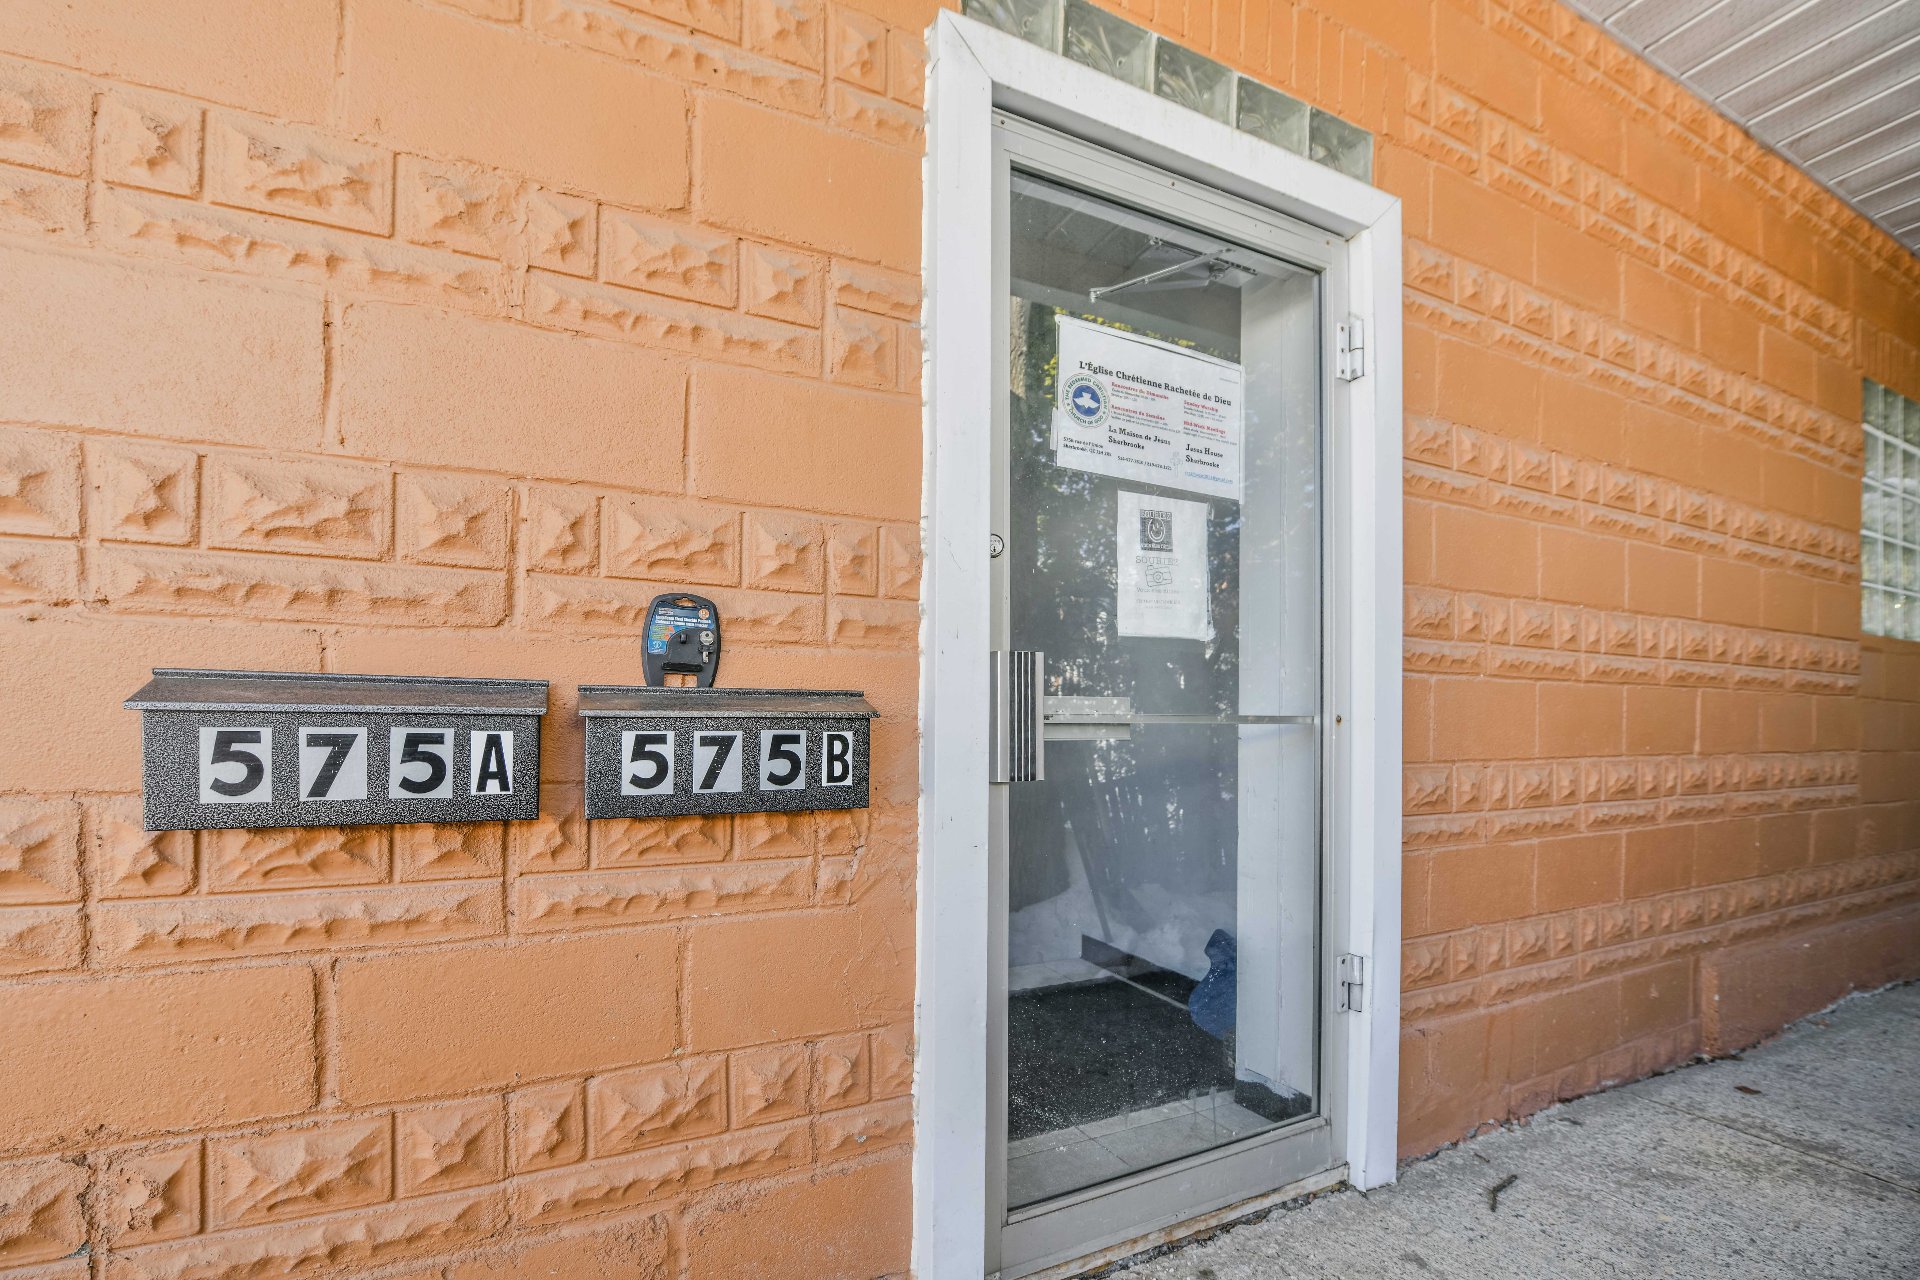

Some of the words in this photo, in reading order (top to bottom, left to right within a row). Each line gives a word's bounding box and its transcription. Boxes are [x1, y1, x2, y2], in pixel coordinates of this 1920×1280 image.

[1079, 360, 1113, 376] L'Église
[1116, 371, 1163, 389] Chrétienne
[1164, 382, 1201, 399] Rachetée
[1203, 392, 1212, 402] de
[1214, 395, 1232, 407] Dieu
[1108, 425, 1118, 434] La
[1118, 427, 1144, 440] Maison
[1108, 435, 1145, 450] Sherbrooke
